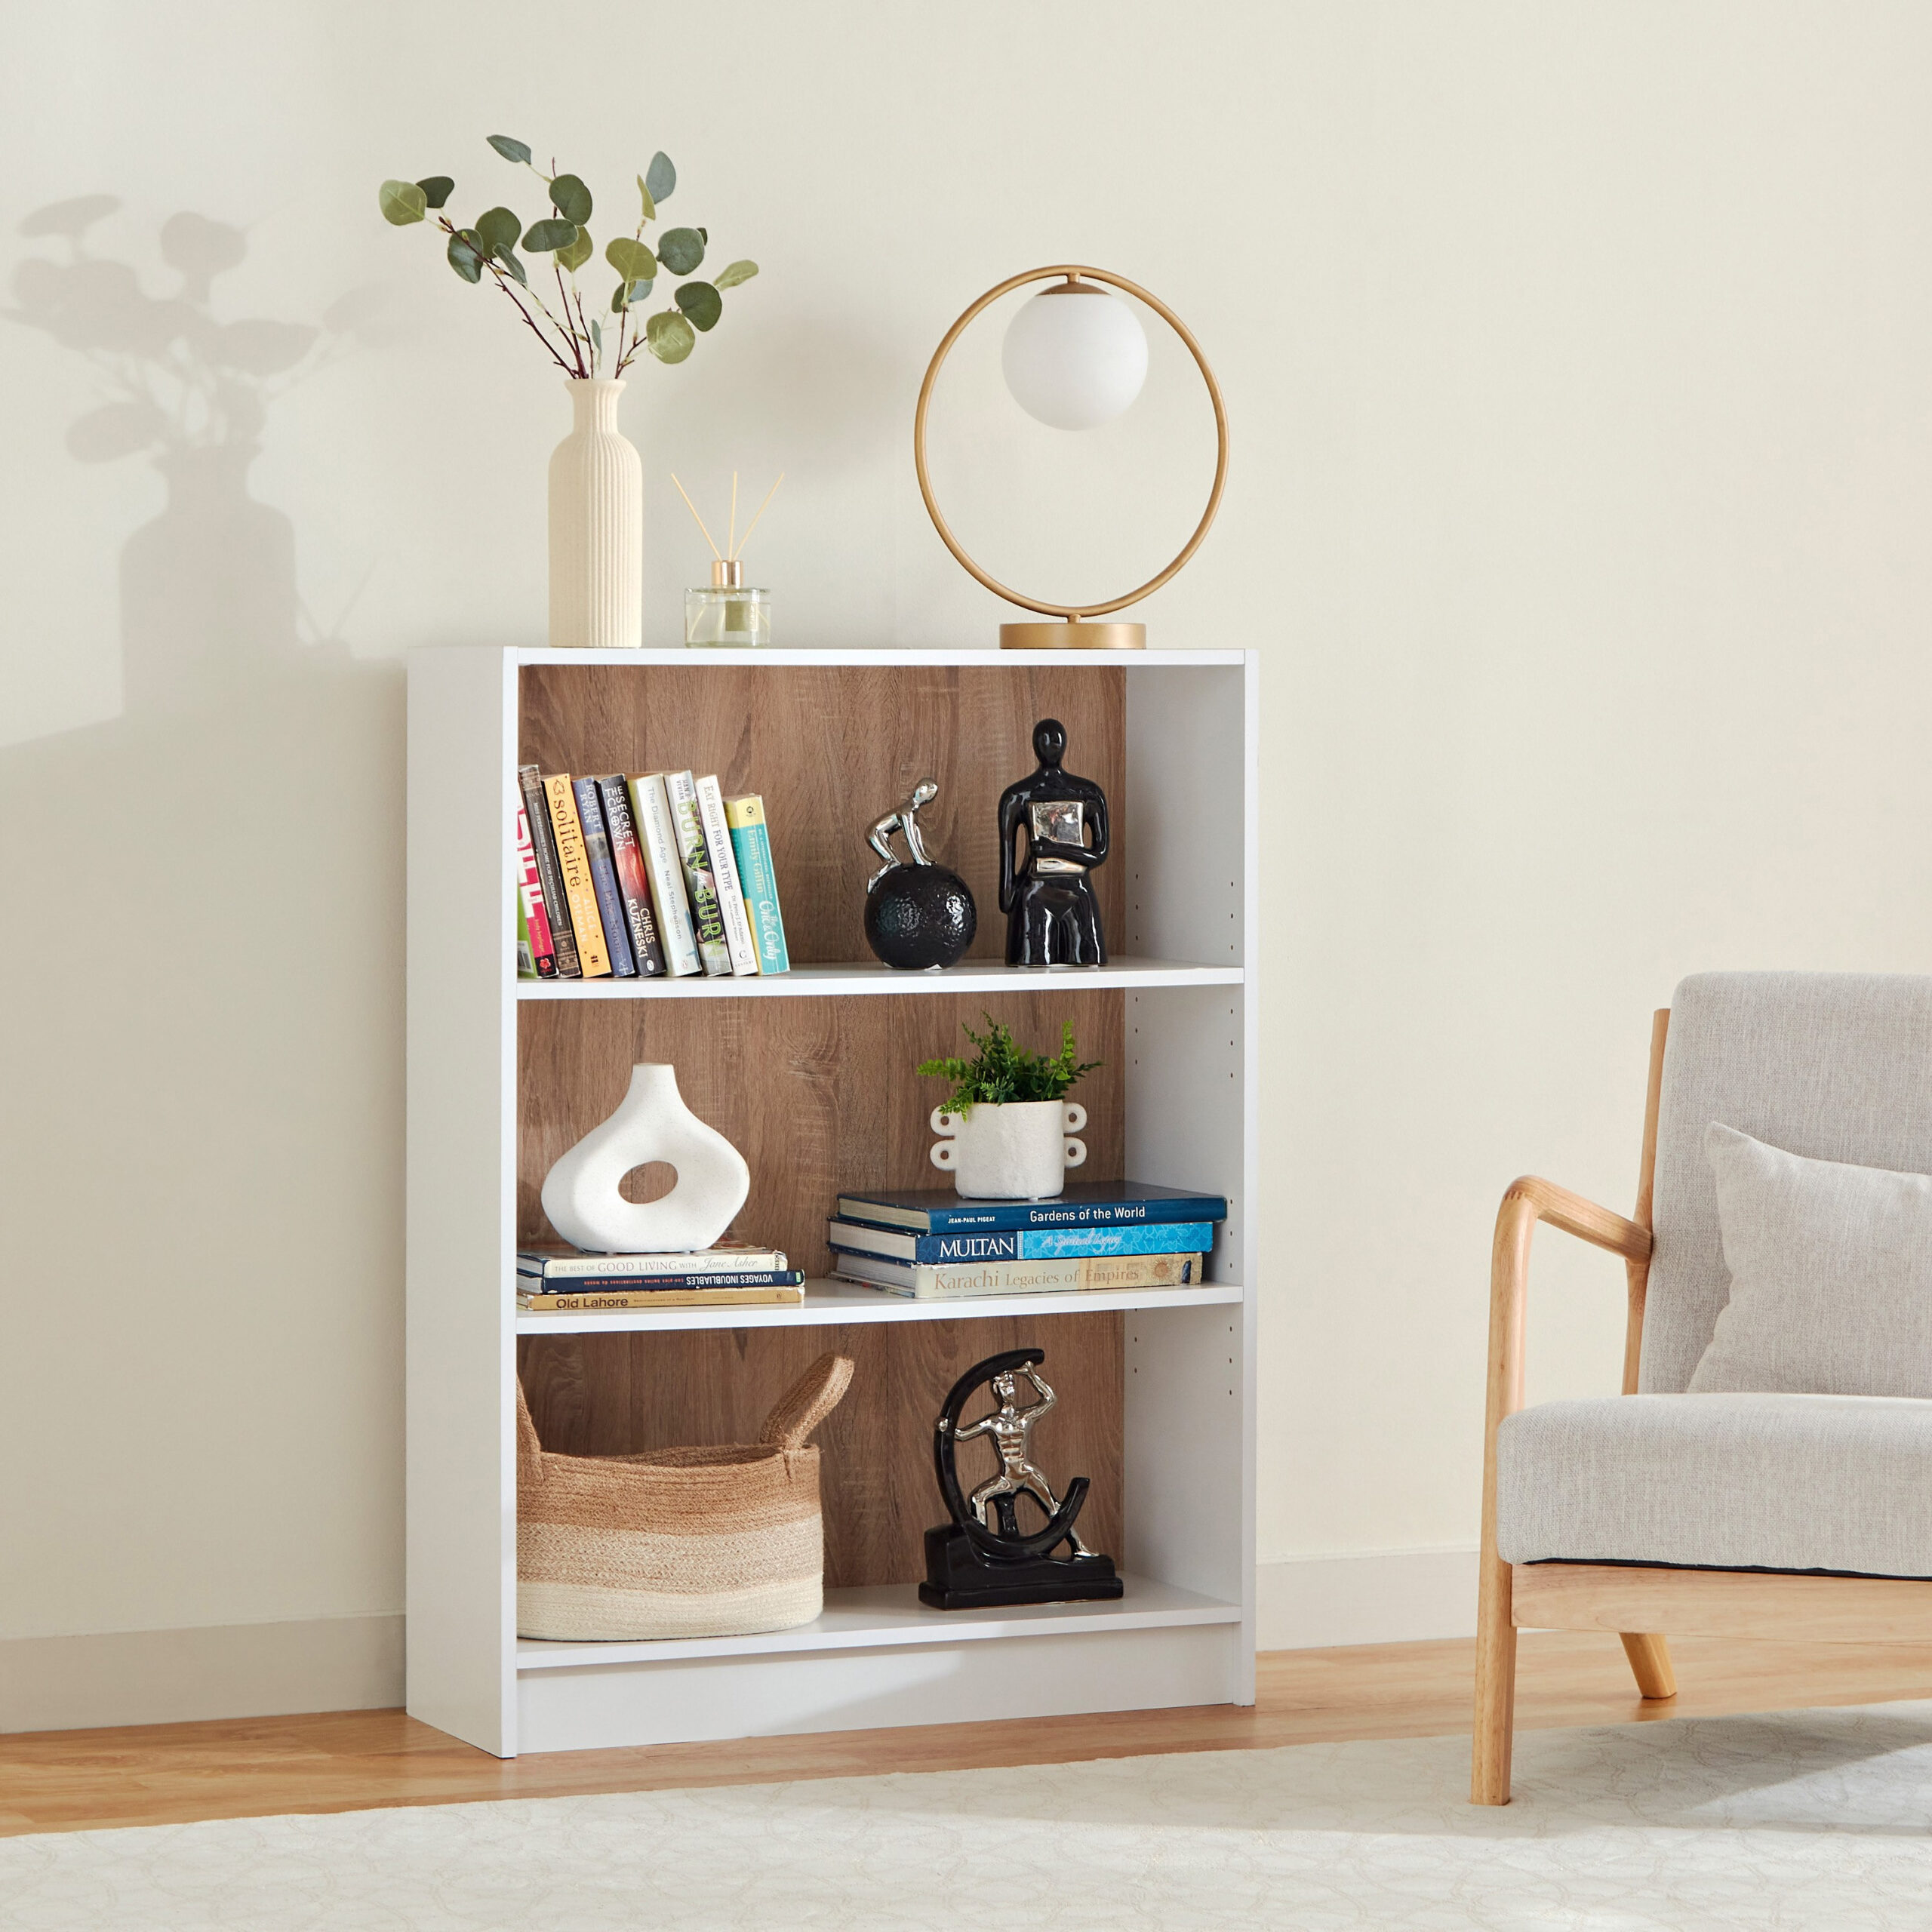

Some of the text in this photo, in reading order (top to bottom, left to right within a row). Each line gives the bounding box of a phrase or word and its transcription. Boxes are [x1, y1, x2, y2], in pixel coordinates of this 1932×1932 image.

[586, 785, 601, 829] ROBERT
[605, 786, 623, 798] THE
[648, 787, 657, 804] The
[580, 795, 592, 823] RYAN
[608, 798, 625, 851] CROWN
[616, 795, 635, 848] SECRET
[652, 806, 664, 844] Diamond
[704, 786, 733, 891] EAT RIGHT FOR YOUR TYPE
[554, 800, 581, 888] solitaire
[659, 847, 669, 863] Age
[747, 829, 759, 860] Emily
[678, 800, 708, 869] BURN
[694, 888, 725, 957] BURN
[548, 875, 557, 900] PECULIAR
[553, 900, 562, 925] CHILDREN
[584, 899, 596, 930] ALICE
[759, 900, 774, 926] One
[572, 894, 587, 942] OSEMAN
[628, 899, 648, 958] KUZNESKI
[640, 908, 655, 943] CHRIS
[669, 892, 681, 940] Stephenson
[763, 931, 781, 960] Only
[1030, 1206, 1146, 1223] Gardens of the World
[940, 1237, 1014, 1257] MULTAN
[598, 1263, 634, 1272] GOOD
[639, 1261, 676, 1271] LIVING
[700, 1257, 725, 1271] Jane
[728, 1257, 758, 1268] Asher
[686, 1275, 740, 1285] INOUBLIABLES
[740, 1274, 773, 1284] VOYAGES
[935, 1269, 1140, 1290] Karachi Legacies of Empires
[556, 1298, 628, 1309] Old Lahore
